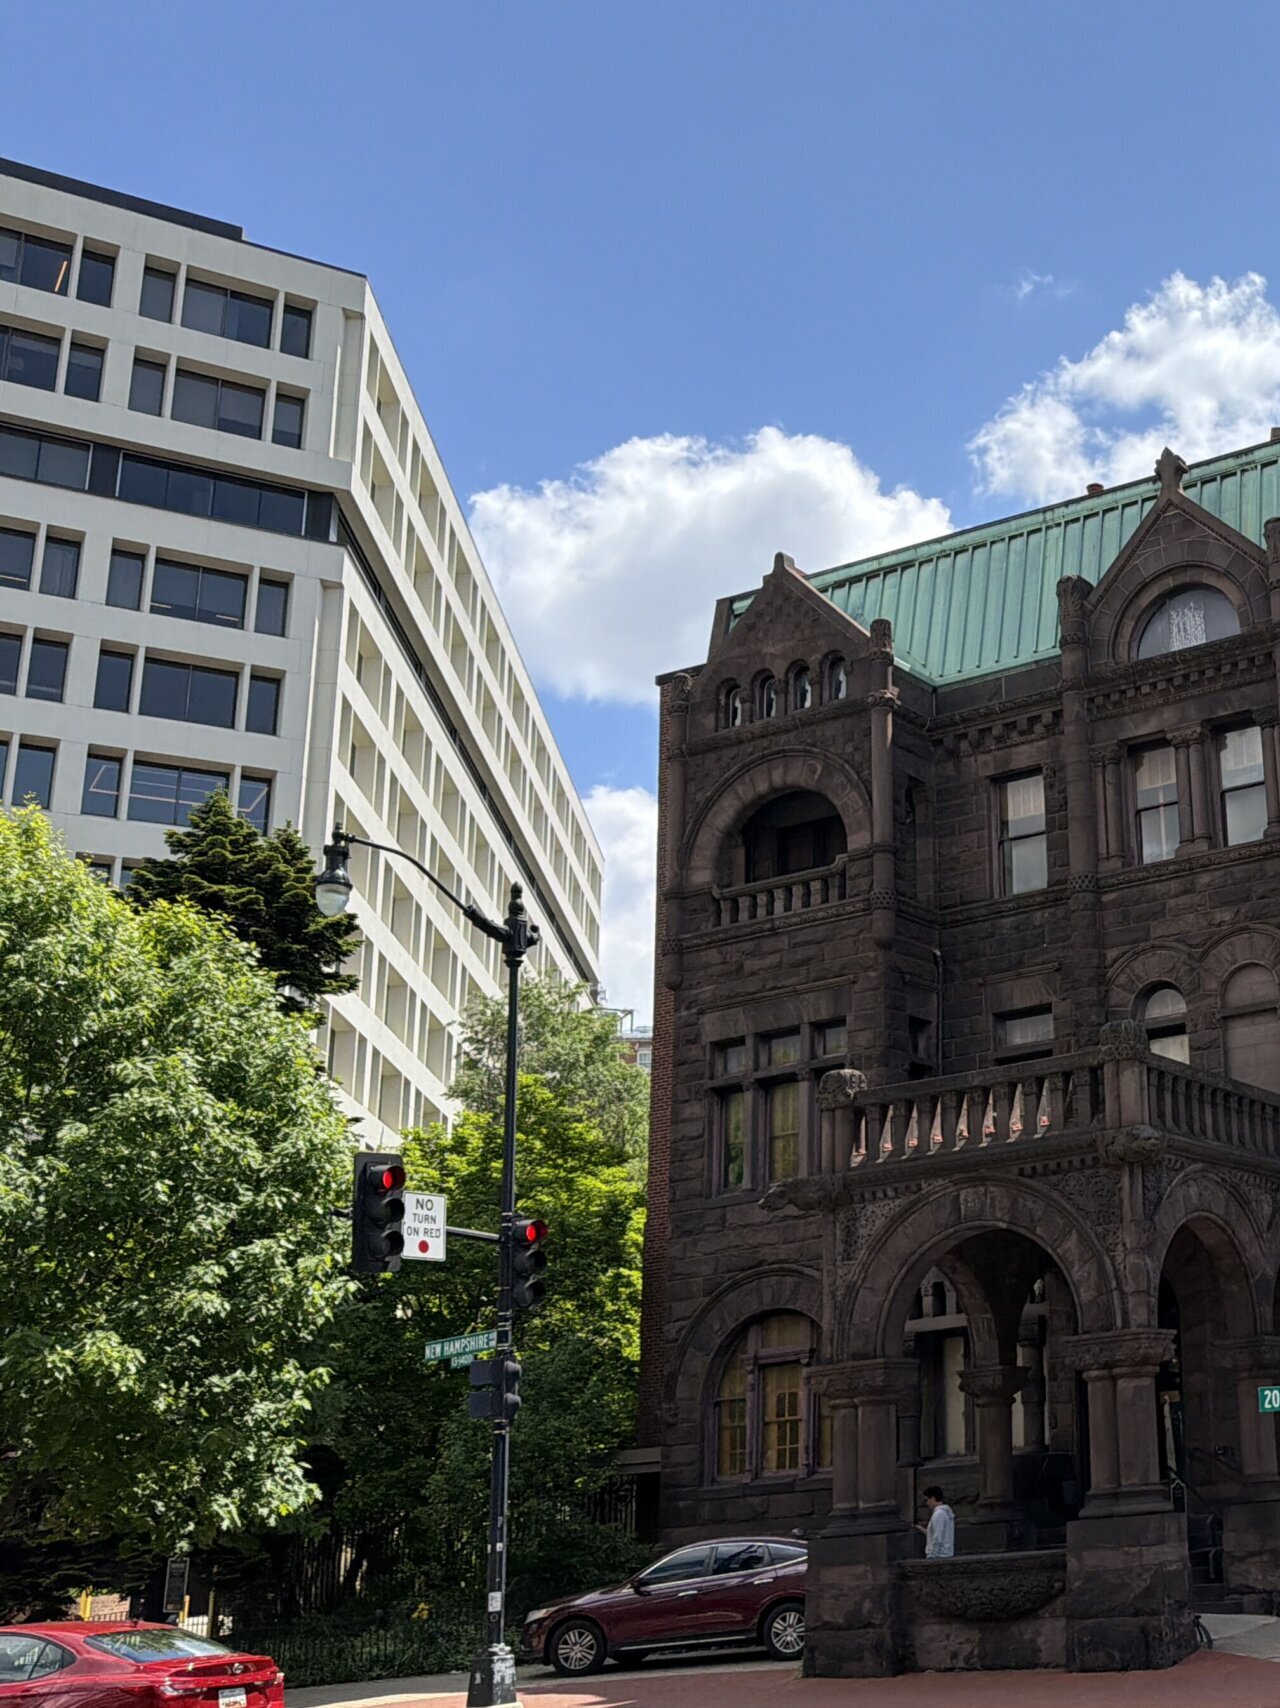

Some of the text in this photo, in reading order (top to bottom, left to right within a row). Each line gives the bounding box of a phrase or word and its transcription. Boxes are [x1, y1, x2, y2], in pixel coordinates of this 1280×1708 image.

[416, 1198, 434, 1211] NO
[412, 1213, 437, 1225] TURN
[406, 1226, 442, 1239] ON RED
[425, 1333, 489, 1360] NEW HAMPSHIRE
[1264, 1390, 1280, 1408] 20
